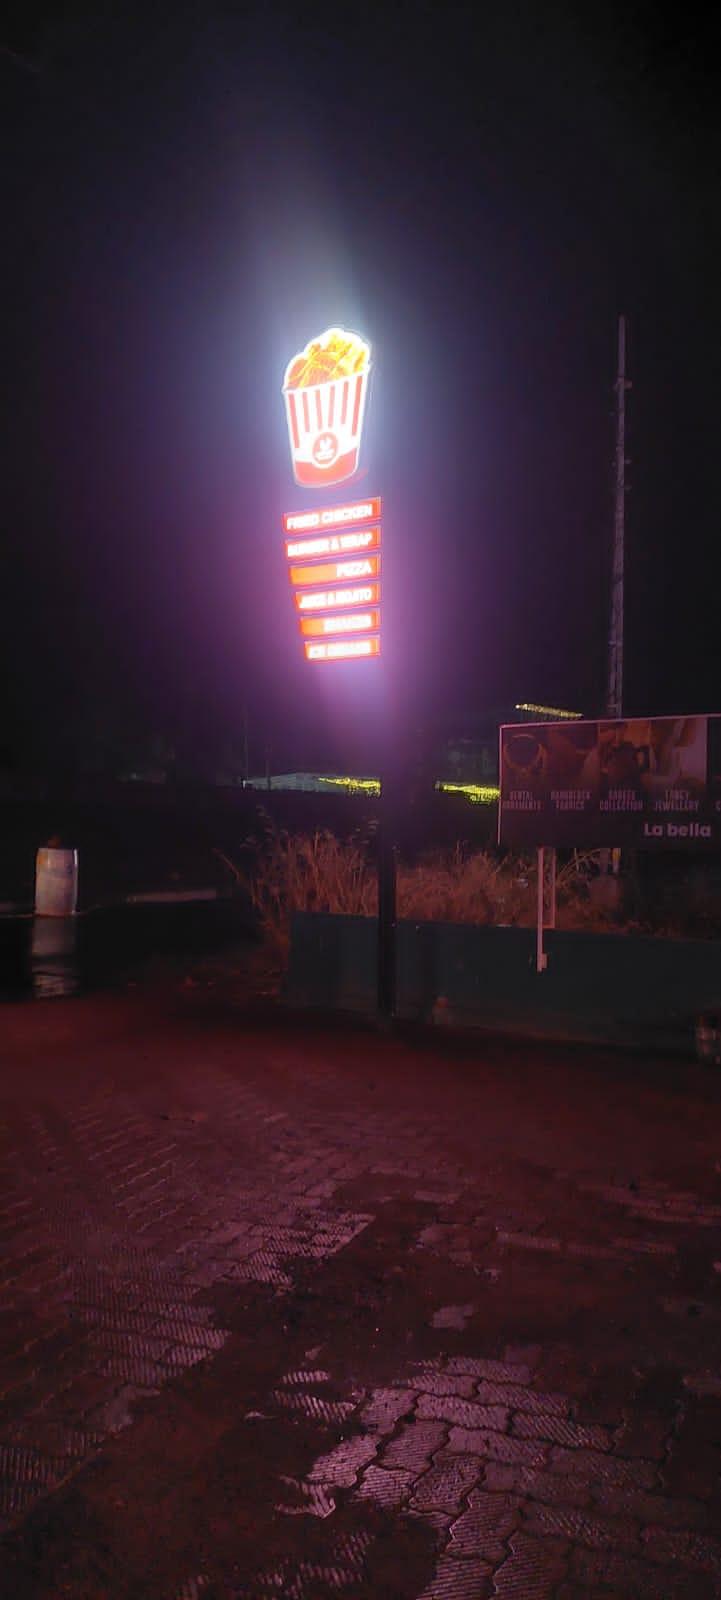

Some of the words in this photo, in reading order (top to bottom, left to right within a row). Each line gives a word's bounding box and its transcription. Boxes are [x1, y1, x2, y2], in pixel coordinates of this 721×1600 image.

[286, 513, 319, 530] FRIED
[321, 505, 372, 524] CHICKEN
[336, 560, 372, 577] PIZZA
[335, 587, 372, 604] MOJITO
[599, 800, 644, 810] COLLECTION
[643, 823, 664, 837] La
[667, 823, 712, 837] bella
